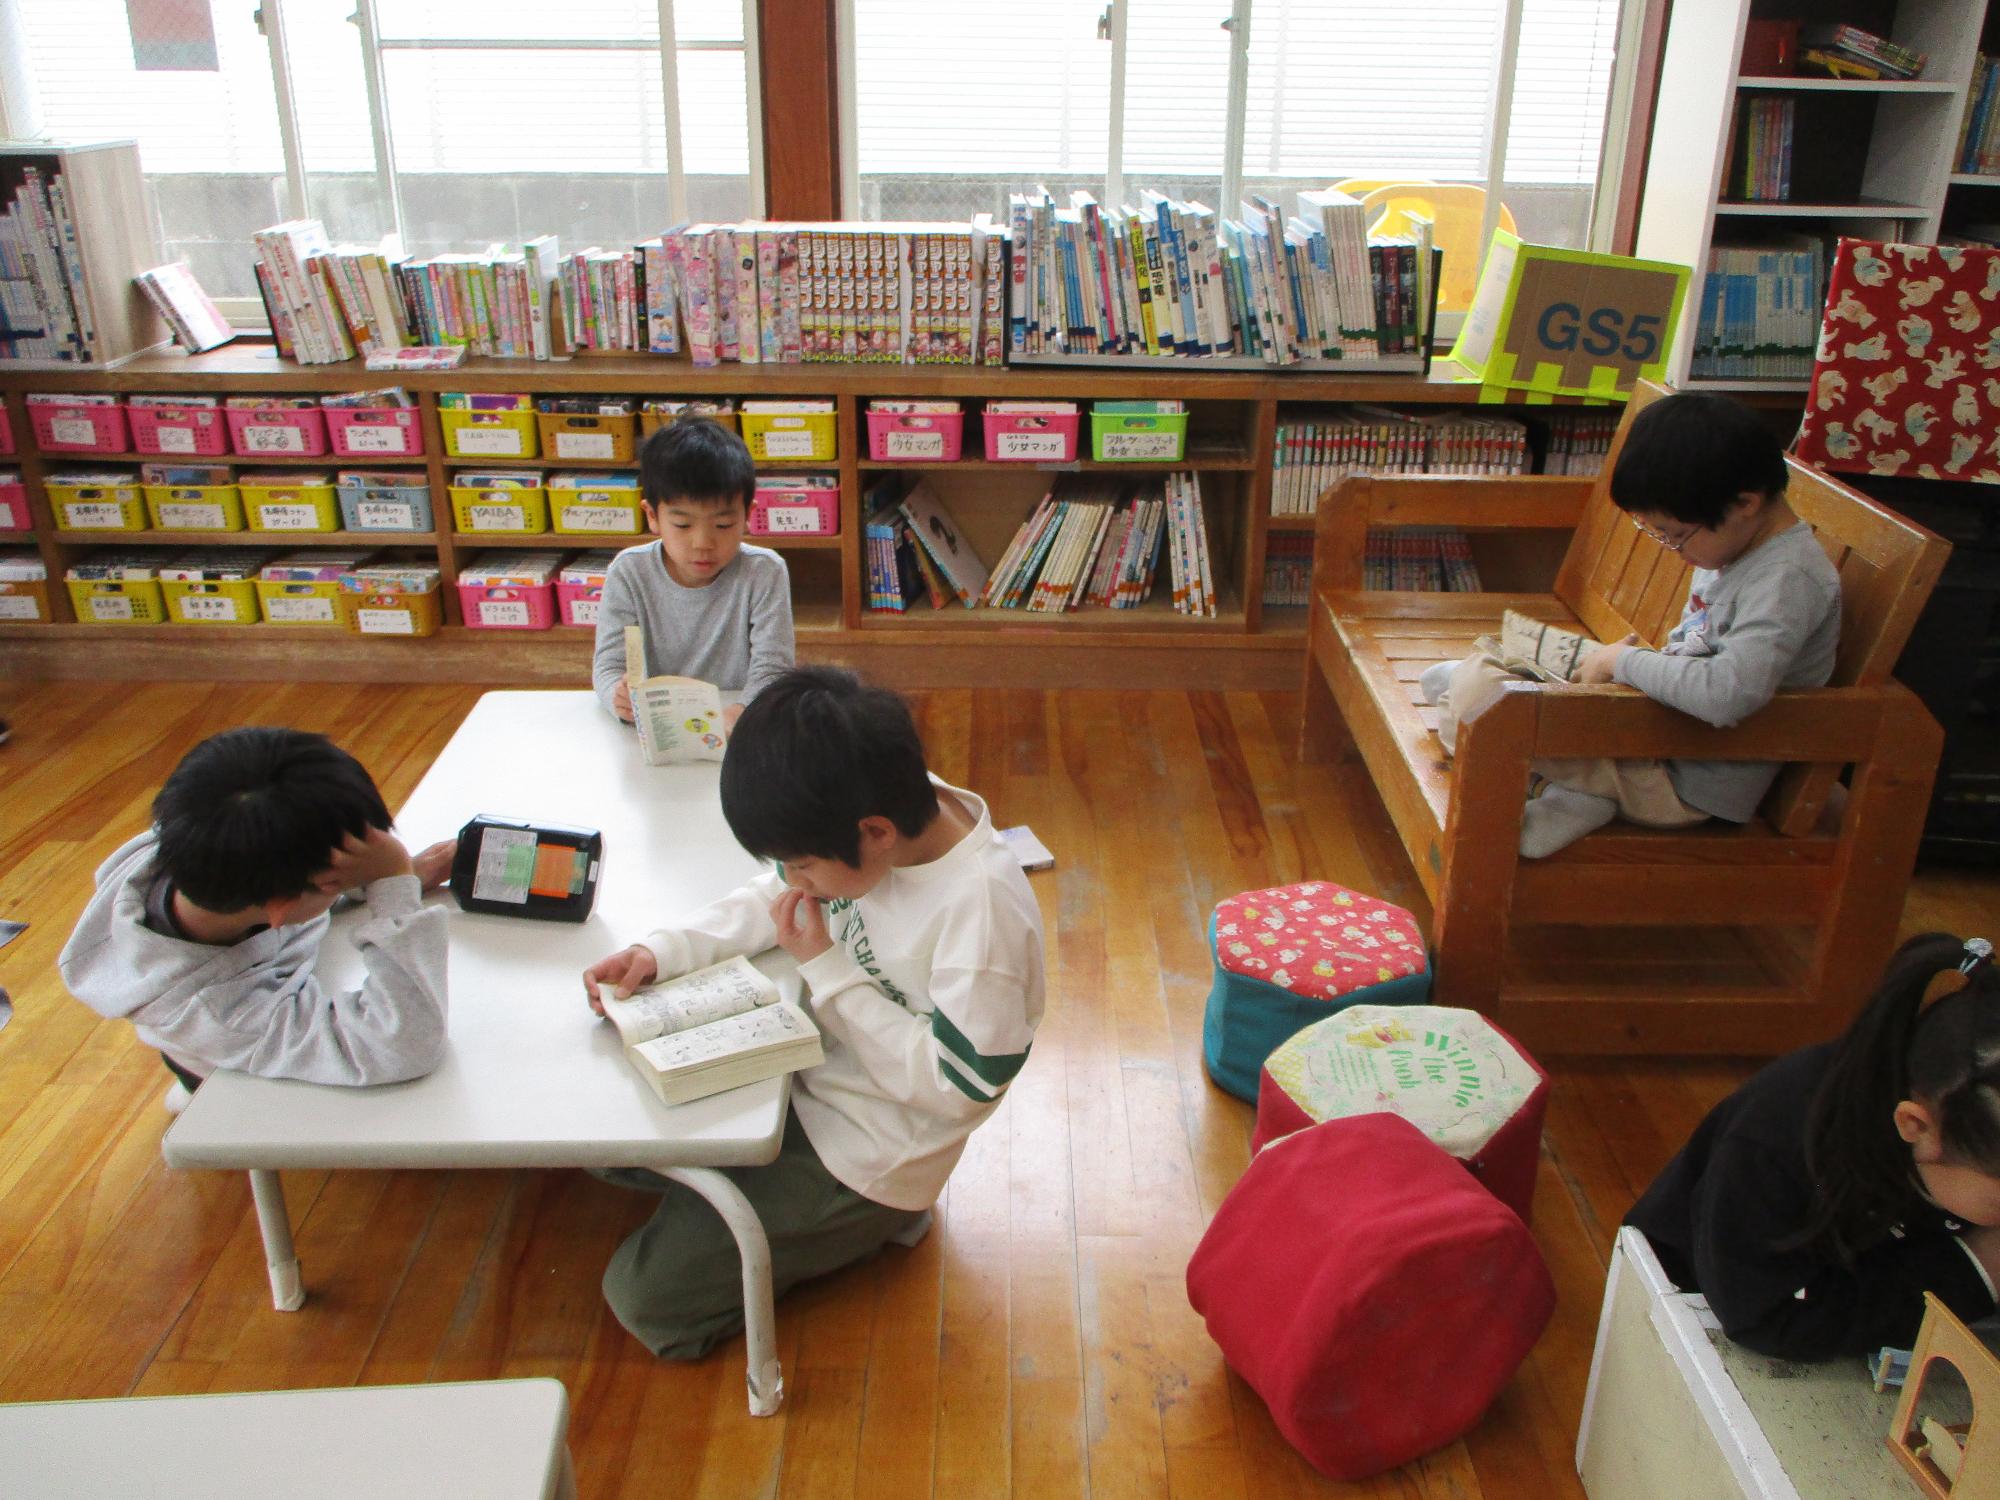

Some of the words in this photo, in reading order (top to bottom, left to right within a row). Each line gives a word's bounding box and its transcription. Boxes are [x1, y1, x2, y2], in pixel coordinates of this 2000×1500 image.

[1537, 303, 1661, 361] GS5
[1007, 441, 1062, 453] 少女マンガ
[474, 507, 516, 518] YAIBA
[1387, 1049, 1422, 1089] Pooh
